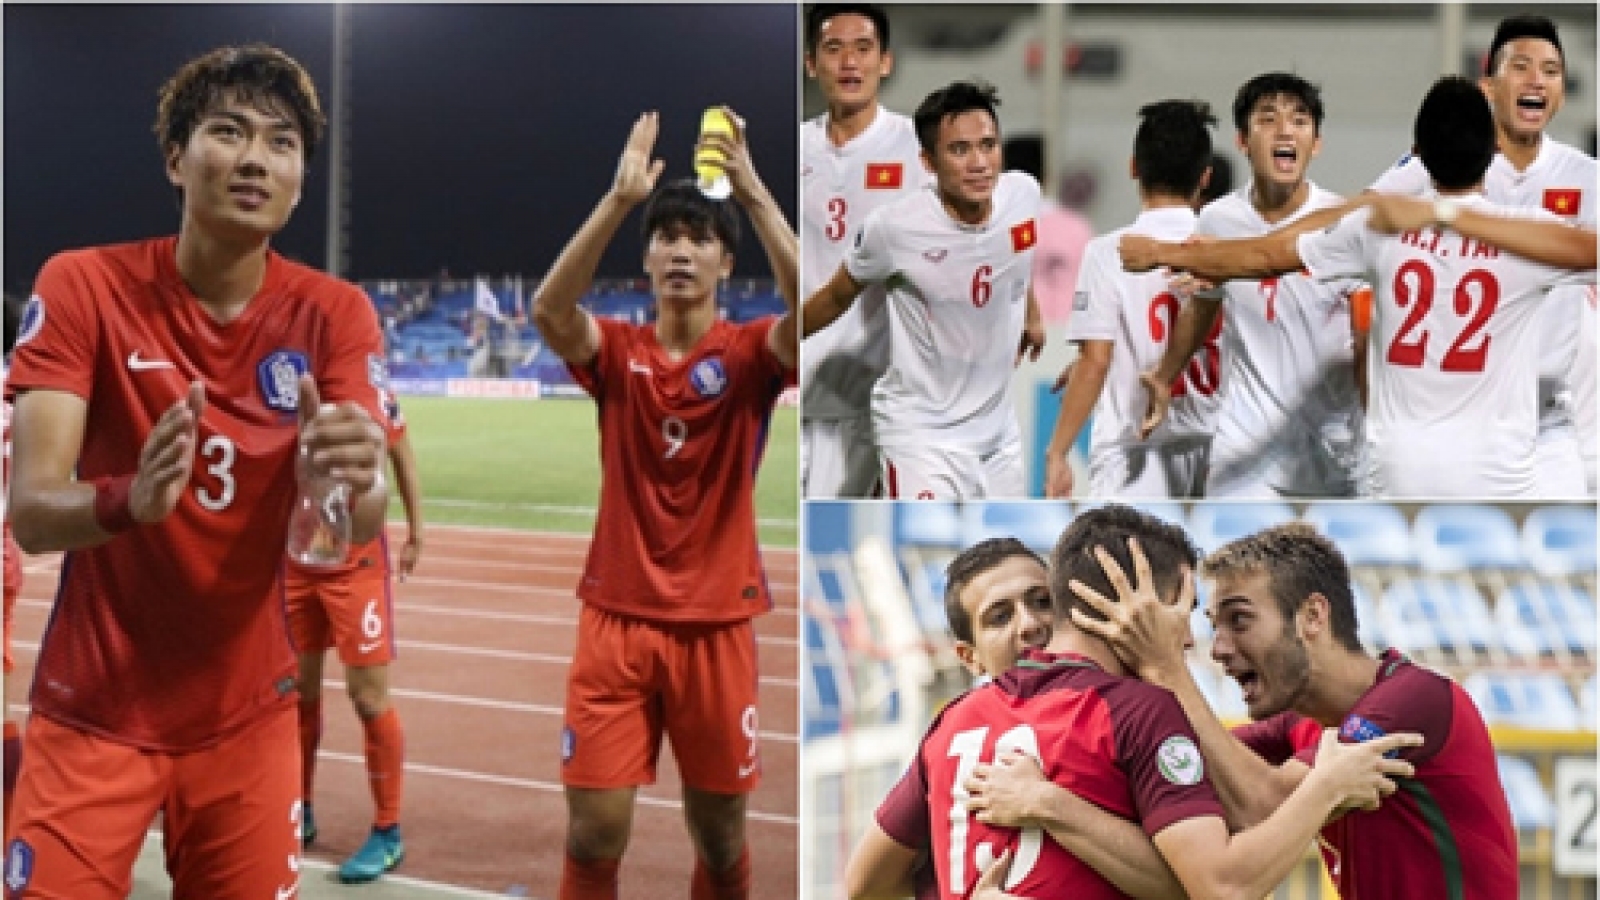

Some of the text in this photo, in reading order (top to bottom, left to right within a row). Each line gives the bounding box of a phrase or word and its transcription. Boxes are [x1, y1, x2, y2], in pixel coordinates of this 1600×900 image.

[825, 198, 847, 240] 3
[971, 265, 993, 308] 6
[1386, 258, 1500, 373] 22
[661, 416, 688, 458] 9
[196, 435, 236, 510] 3
[361, 599, 382, 638] 6
[1570, 779, 1597, 852] 2
